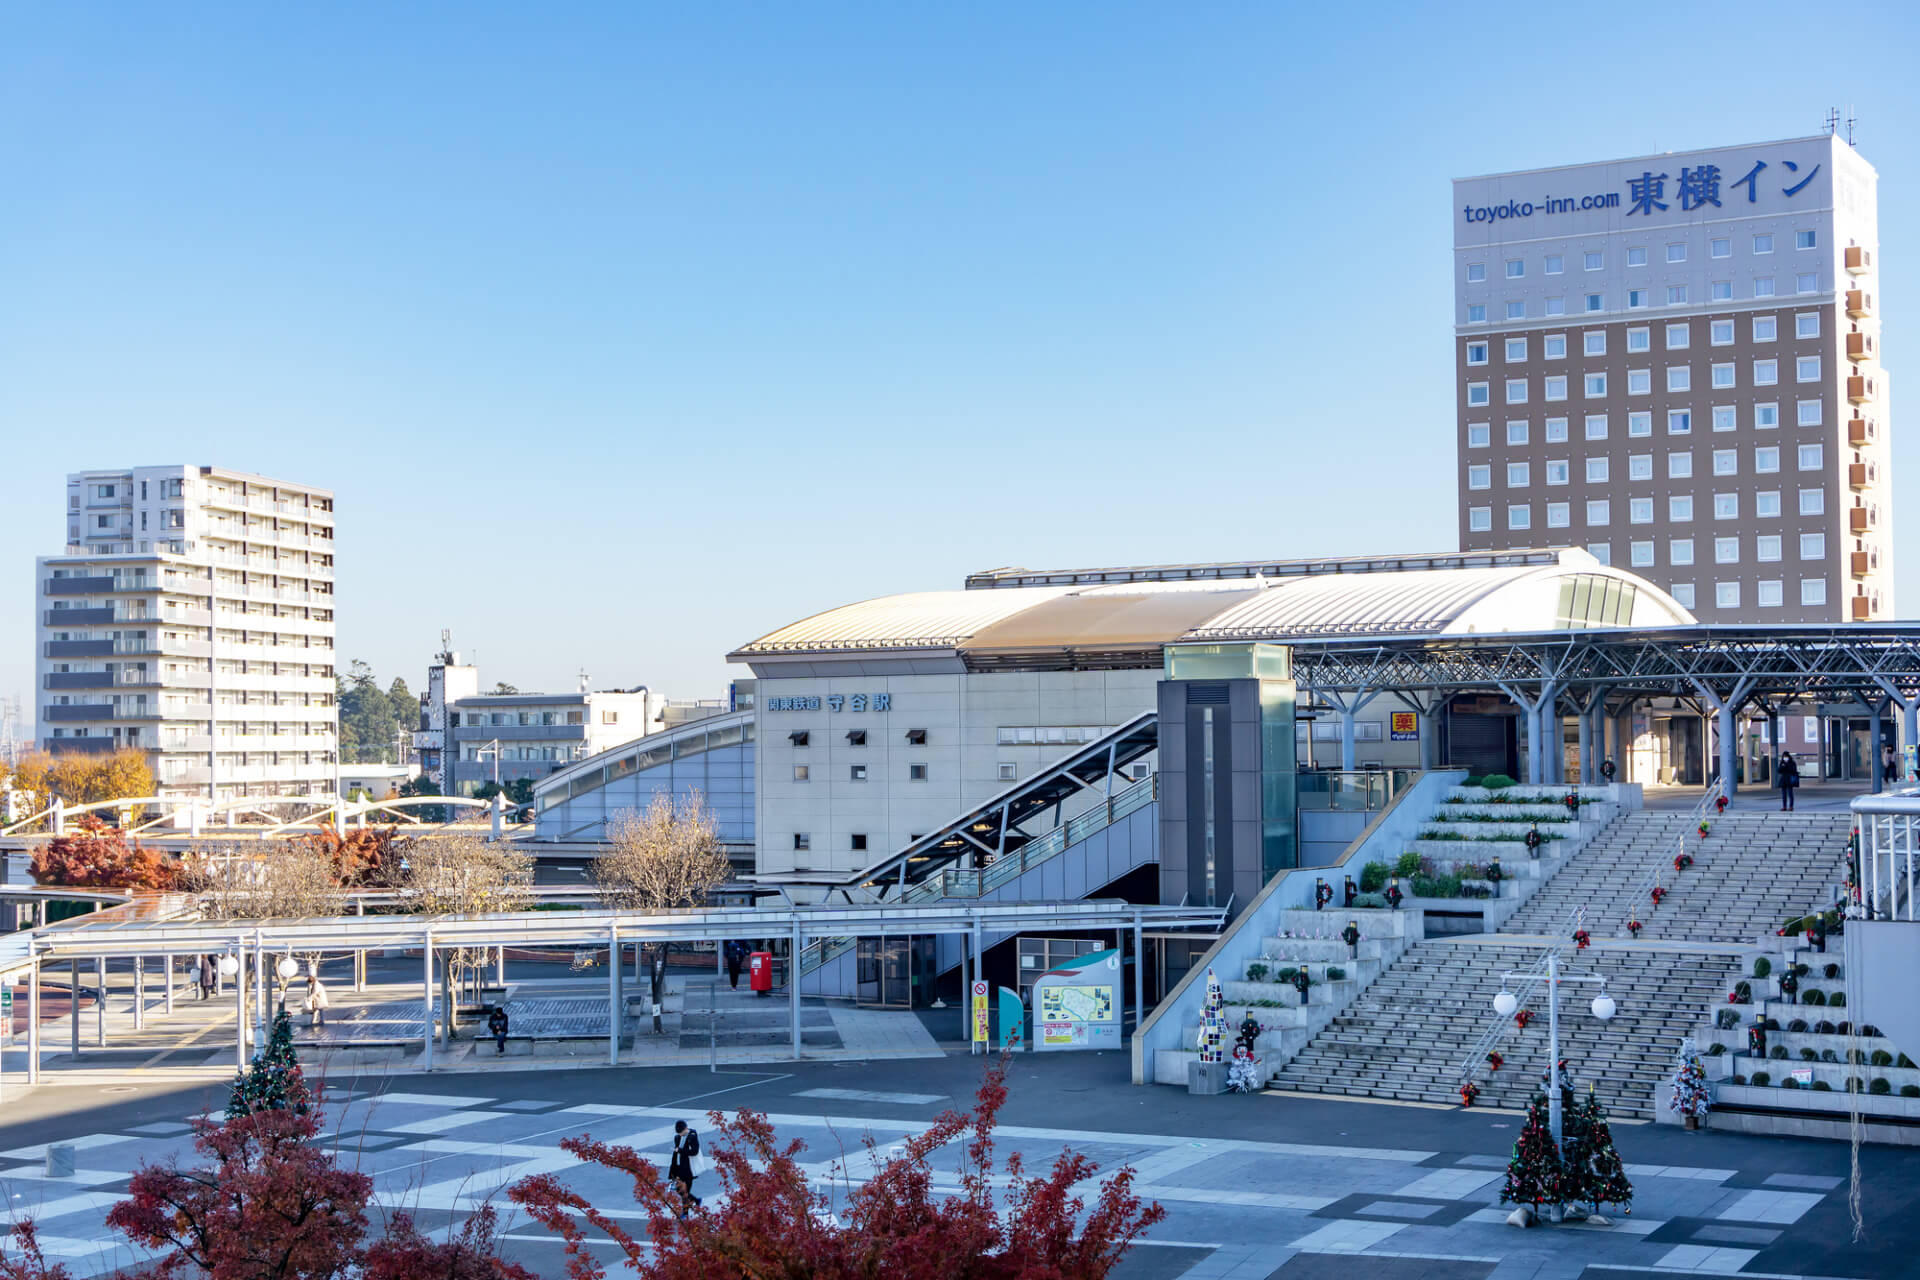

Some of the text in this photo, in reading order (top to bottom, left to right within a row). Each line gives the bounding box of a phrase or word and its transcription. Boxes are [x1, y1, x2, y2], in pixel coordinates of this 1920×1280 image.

[1626, 160, 1821, 217] 東横イン
[1464, 192, 1620, 223] toyoko-inn.com
[768, 693, 891, 713] 関東鉄道 守谷駅
